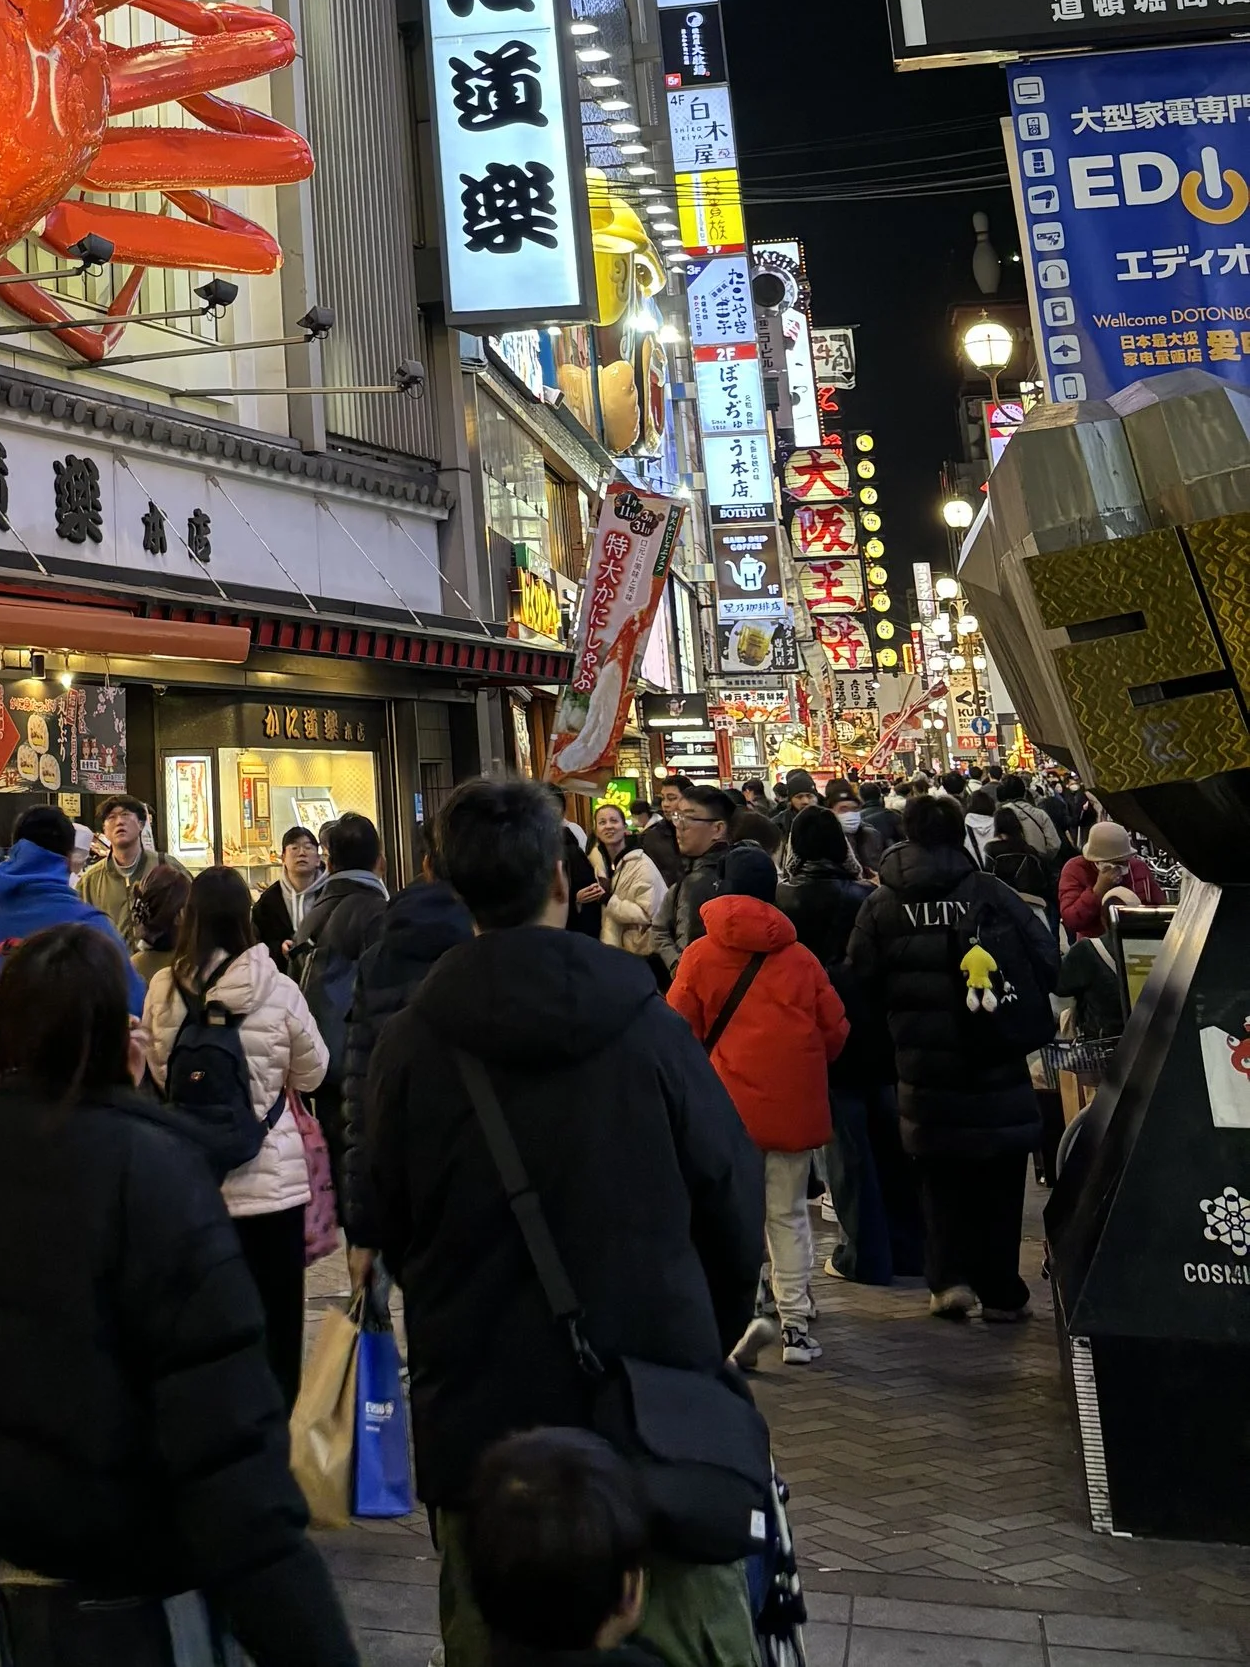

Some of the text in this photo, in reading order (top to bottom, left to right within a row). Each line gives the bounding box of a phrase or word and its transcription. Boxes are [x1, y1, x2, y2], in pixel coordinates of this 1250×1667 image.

[670, 94, 685, 106] 4F
[1070, 94, 1250, 135] 大型家電専門
[690, 97, 729, 165] 白木屋
[686, 265, 701, 275] 3F
[1092, 312, 1168, 329] Wellcome
[716, 347, 736, 361] 2F
[744, 573, 757, 587] H
[767, 584, 780, 595] 1F
[574, 532, 629, 691] 特大かにしゃぶ
[957, 708, 991, 718] KUA
[902, 901, 970, 928] VLTN
